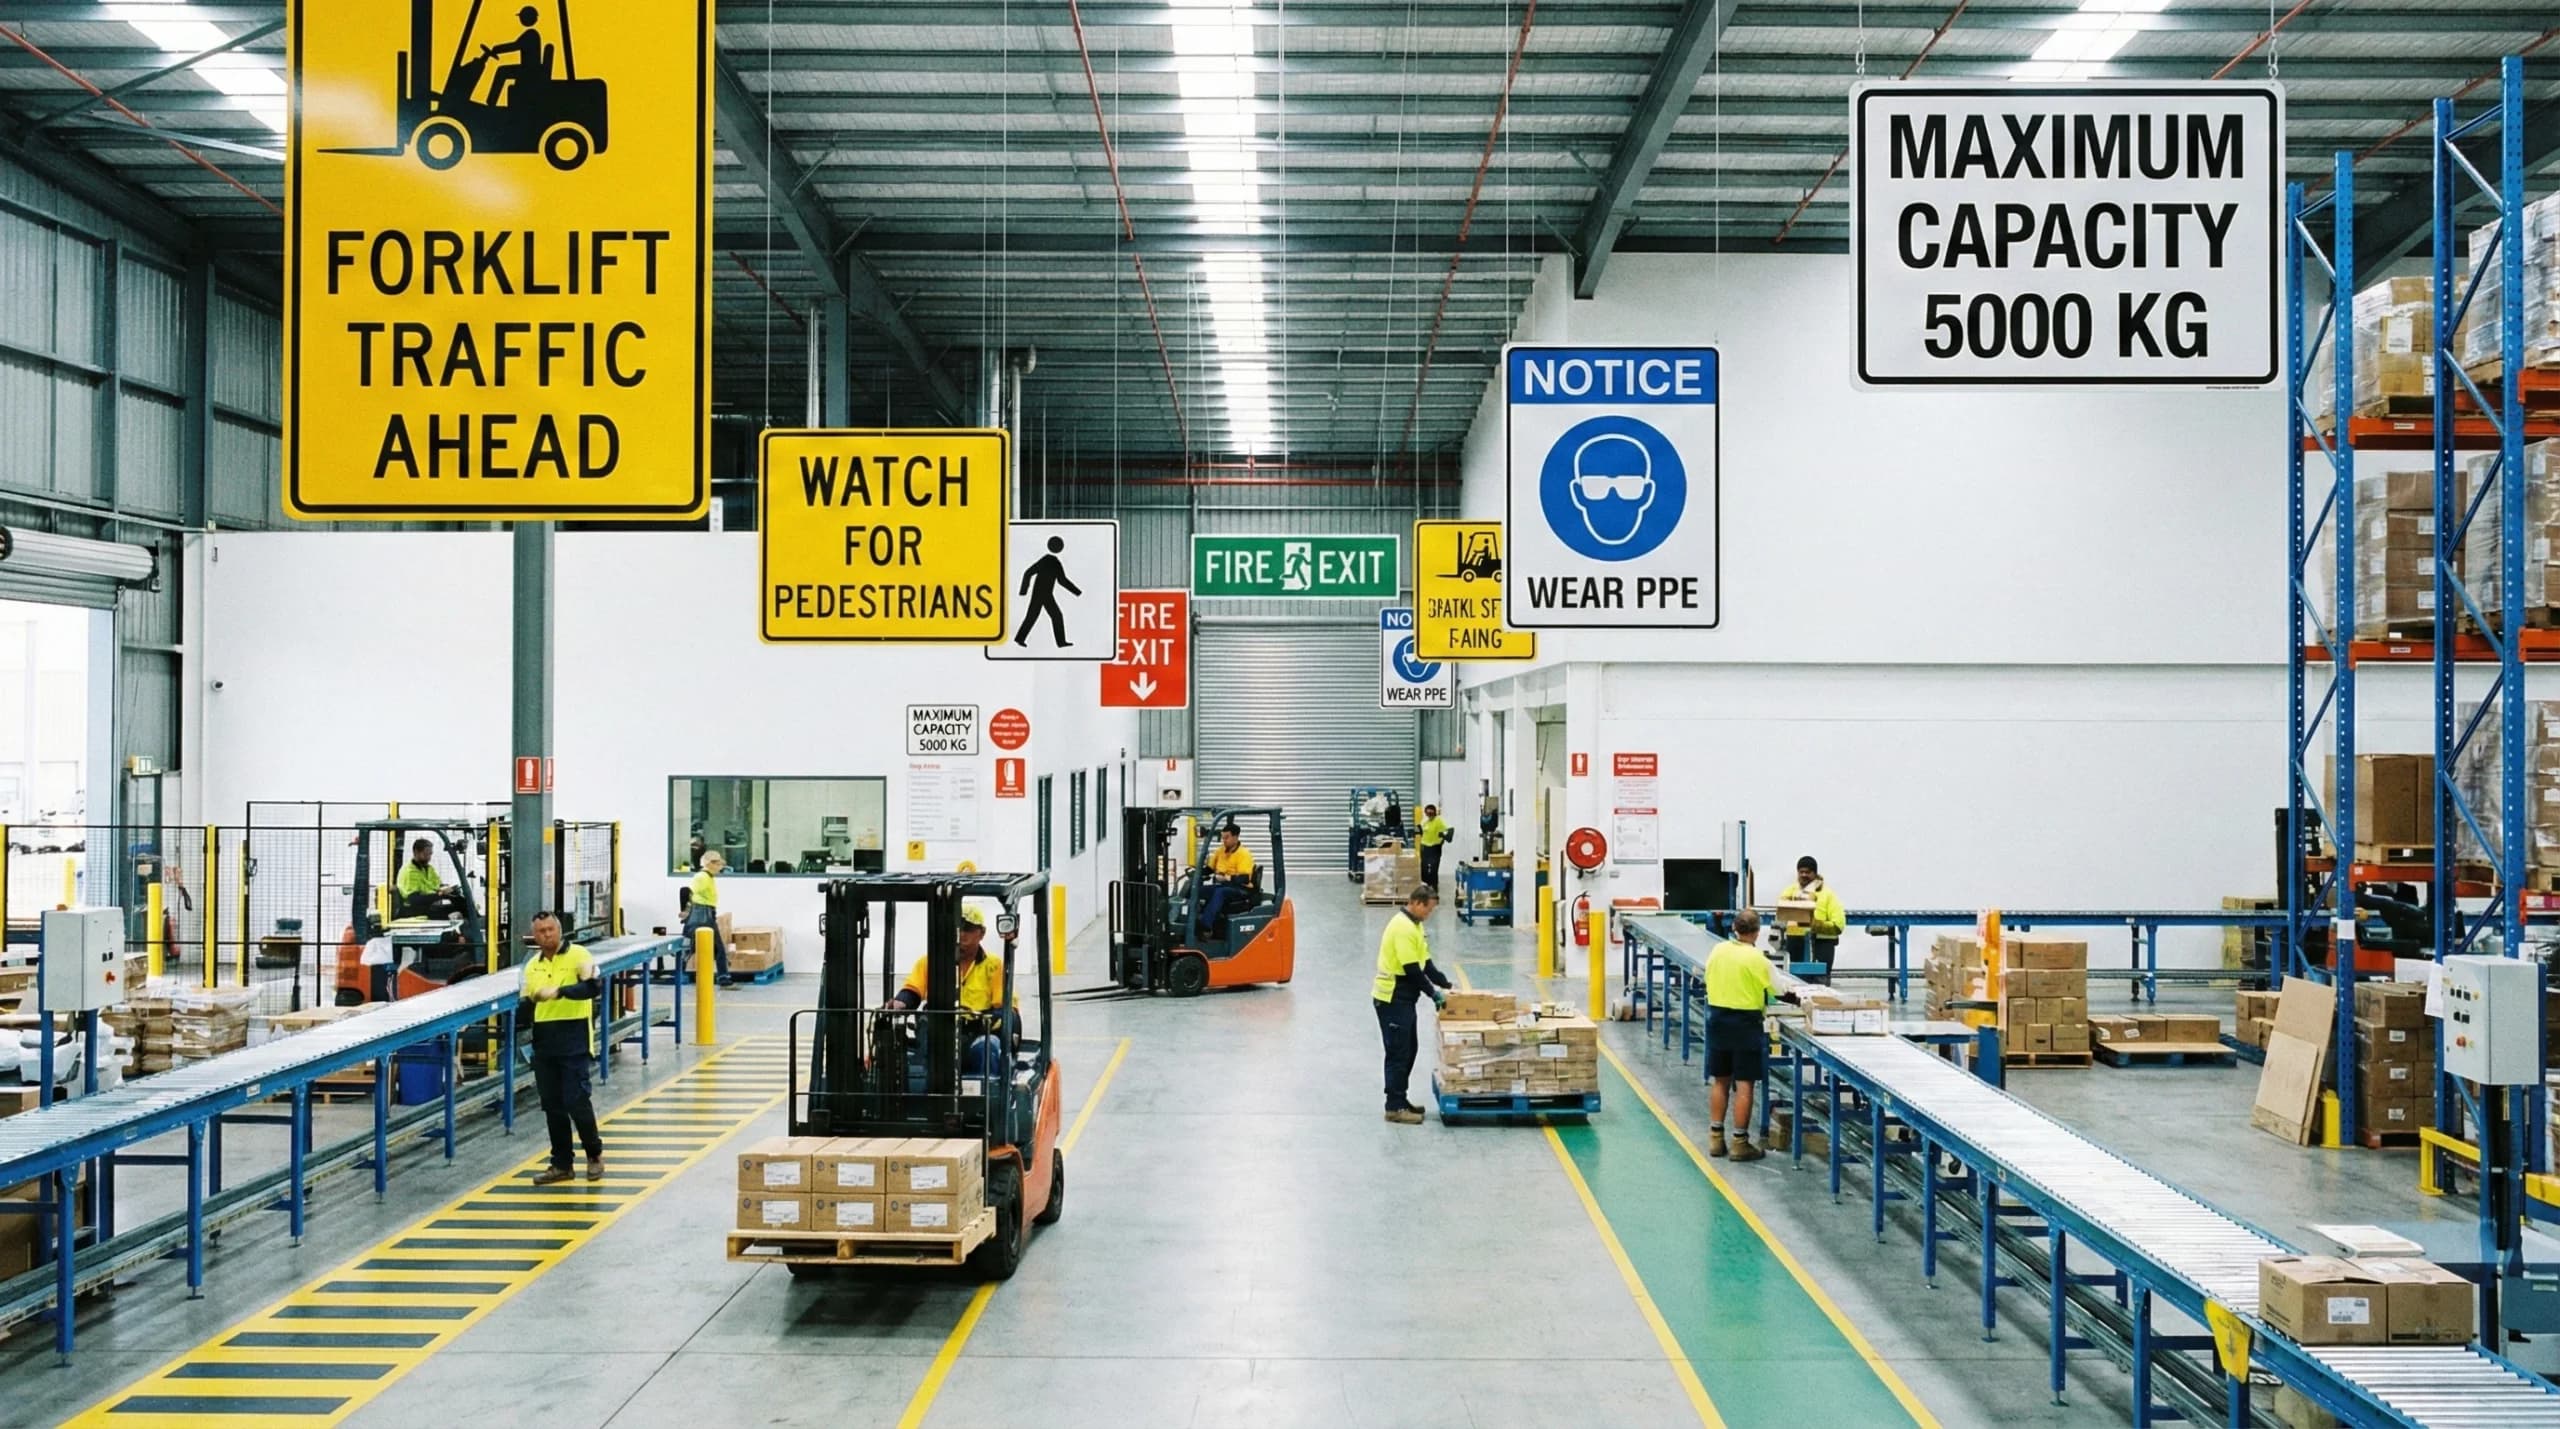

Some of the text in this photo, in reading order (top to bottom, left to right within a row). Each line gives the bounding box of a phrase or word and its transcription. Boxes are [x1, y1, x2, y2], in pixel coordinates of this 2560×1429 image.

[1890, 114, 2244, 179] MAXIMUM
[1898, 202, 2239, 268] CAPACITY
[328, 230, 669, 295] FORKLIFT
[1924, 292, 2208, 358] 5000 KG
[348, 322, 646, 387] TRAFFIC
[1524, 359, 1702, 396] NOTICE
[374, 414, 620, 478] AHEAD
[800, 456, 968, 507] WATCH
[845, 525, 922, 566] FOR
[1206, 551, 1385, 584] FIRE EXIT
[775, 584, 993, 619] PEDESTRIANS
[1528, 577, 1699, 608] WEAR PPE
[1113, 638, 1175, 666] EXIT
[1387, 688, 1447, 701] WEAR PPE
[913, 709, 972, 721] MAXIMUM
[913, 723, 971, 735] CAPACITY
[919, 739, 967, 751] 5000 KG
